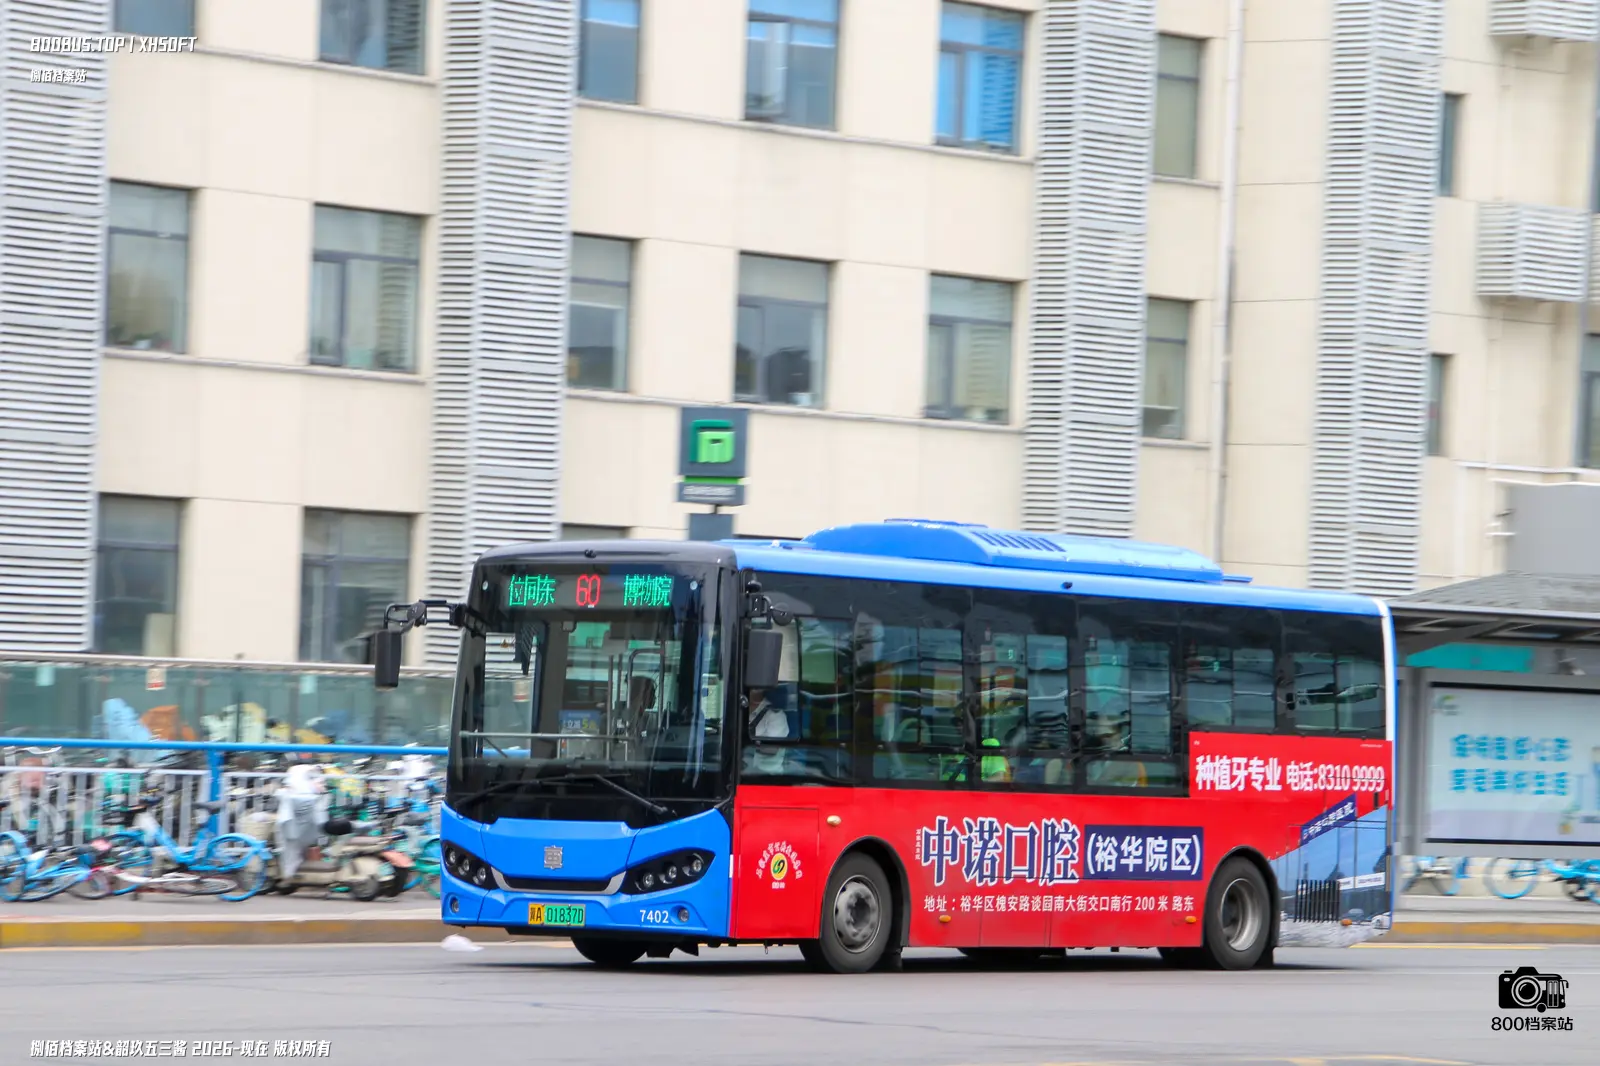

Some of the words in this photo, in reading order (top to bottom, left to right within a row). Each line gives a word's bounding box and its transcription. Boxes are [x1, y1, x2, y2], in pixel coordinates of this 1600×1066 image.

[575, 574, 601, 606] 60
[623, 574, 673, 607] 博物院
[1195, 754, 1283, 792] 种植牙专业
[1352, 765, 1385, 792] 9999
[920, 815, 1081, 887] 中诺口腔
[546, 907, 584, 924] 01837D
[639, 909, 670, 923] 7402
[1135, 896, 1155, 911] 200
[1157, 895, 1168, 912] 米
[1171, 895, 1194, 912] 路东
